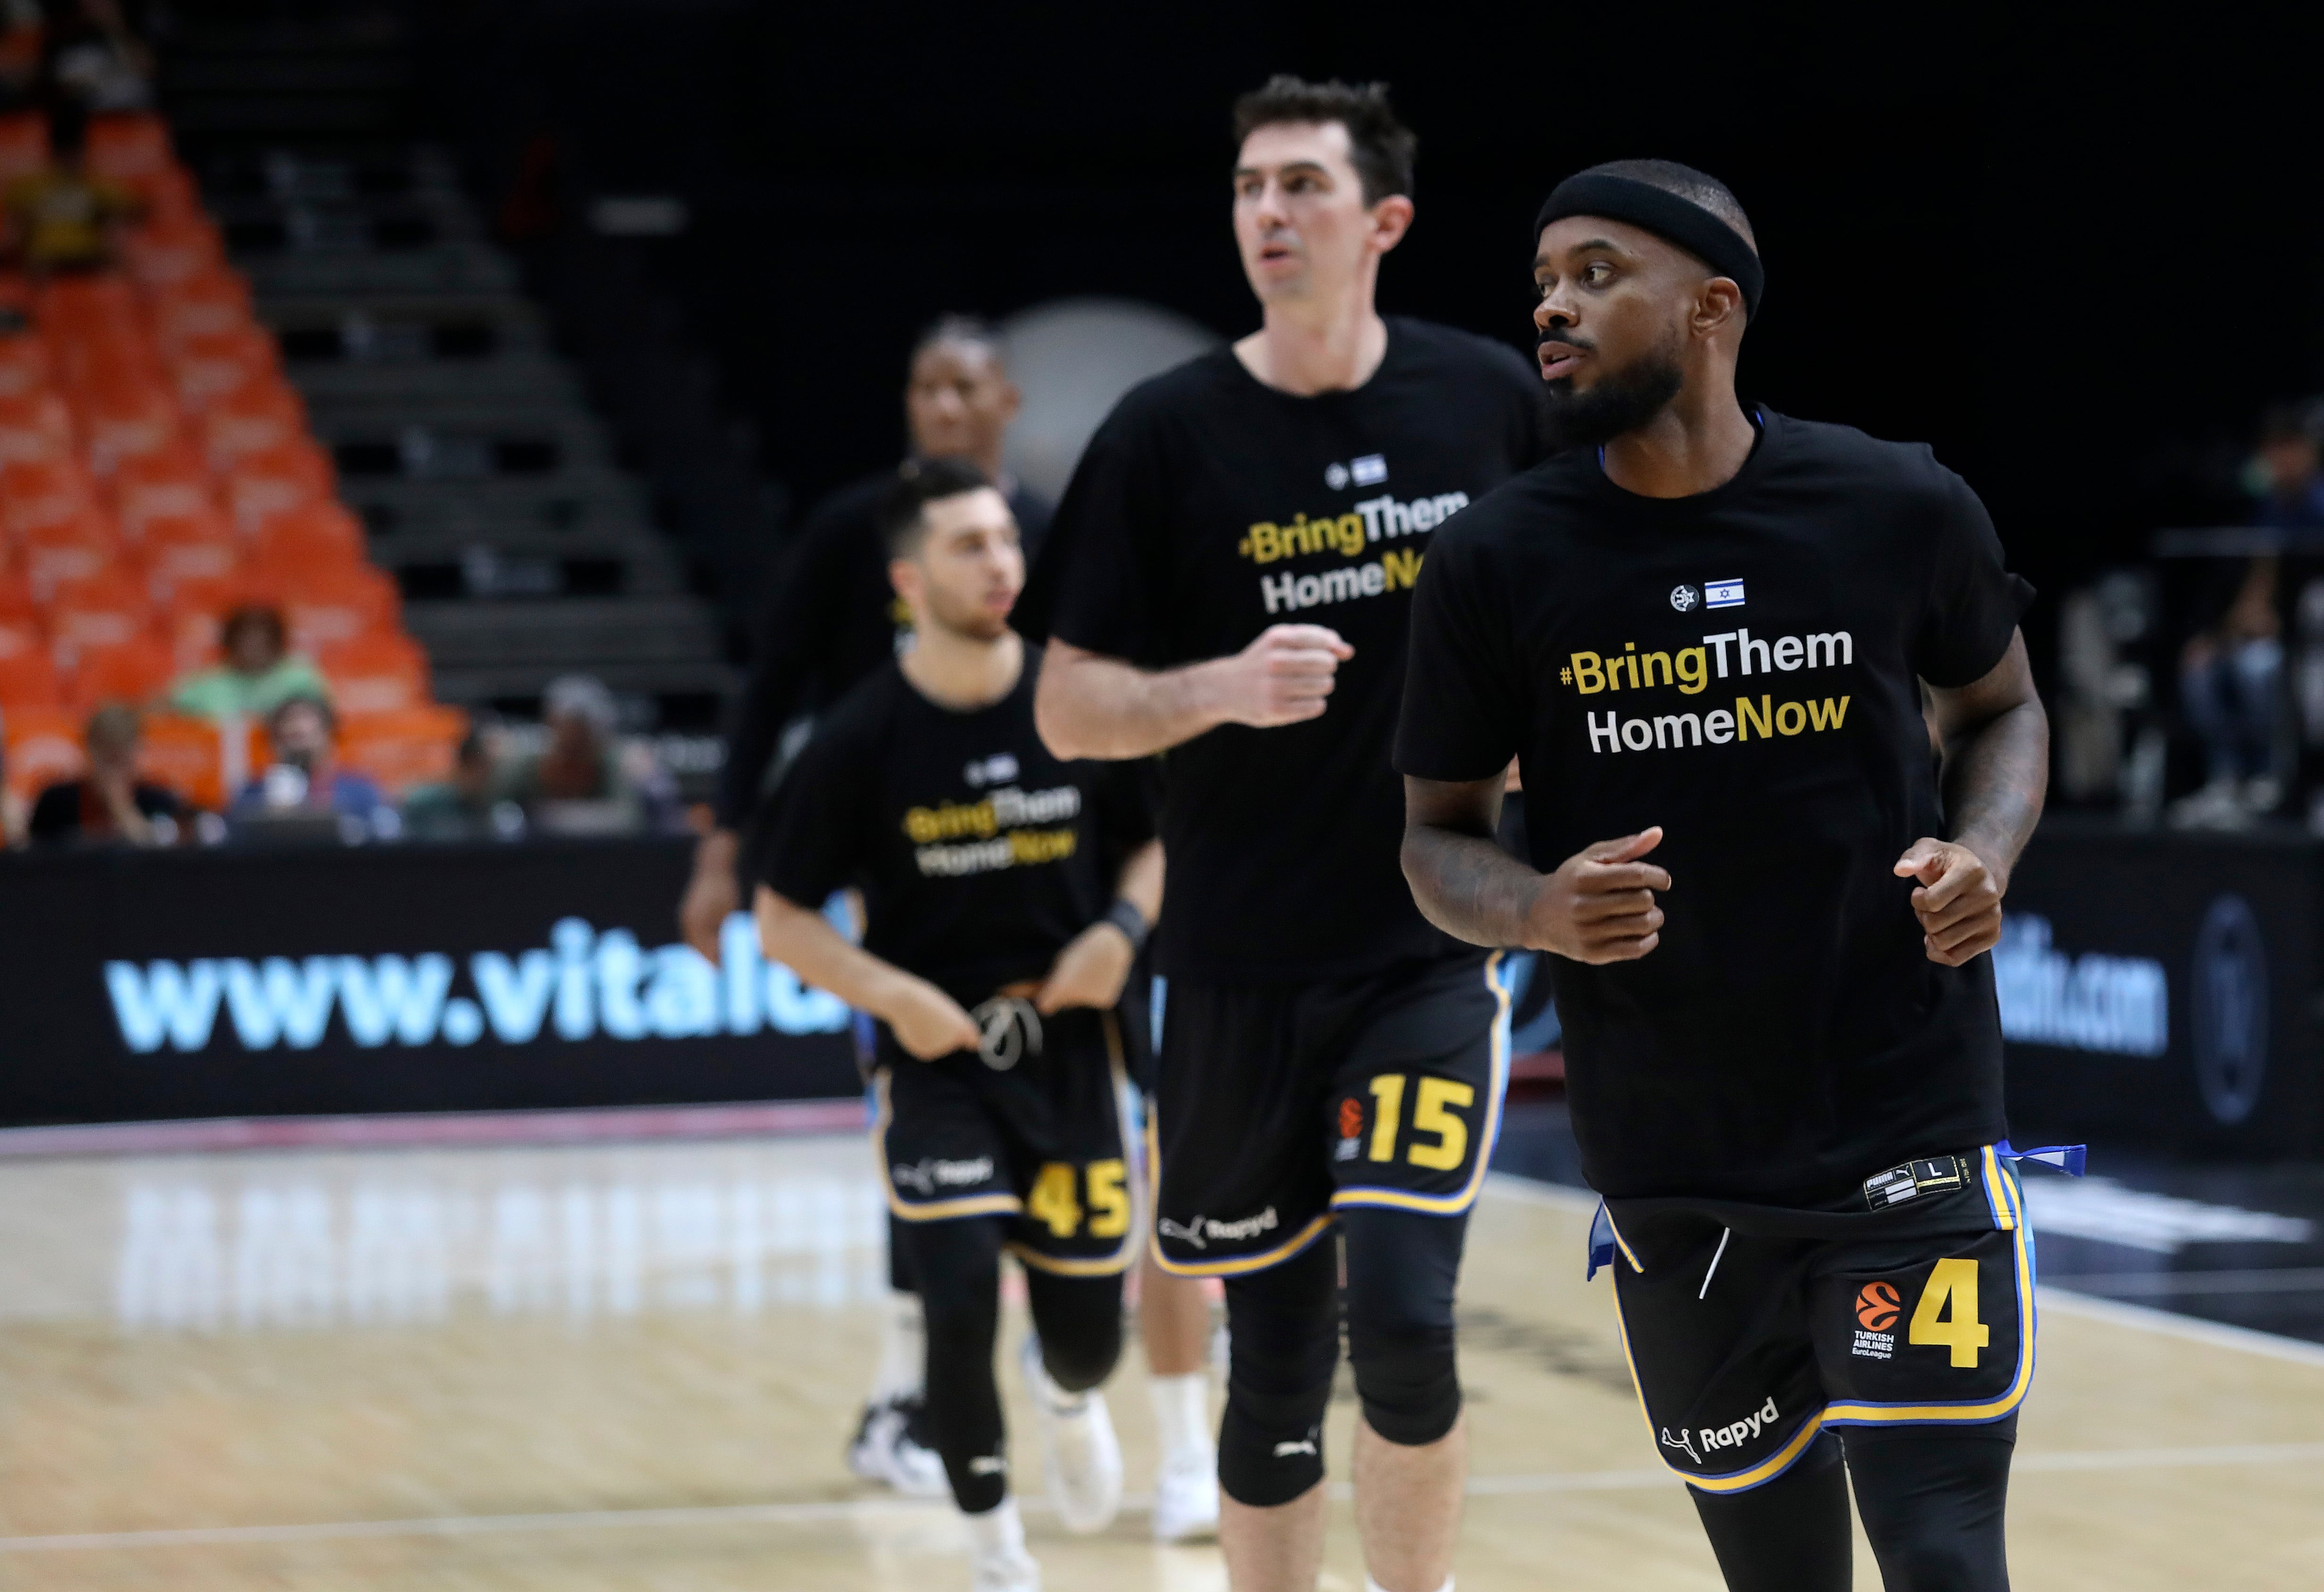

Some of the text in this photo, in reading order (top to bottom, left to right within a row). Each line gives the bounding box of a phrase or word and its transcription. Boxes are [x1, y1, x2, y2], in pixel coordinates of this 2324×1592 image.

[1260, 547, 1424, 614] HomeN
[1560, 628, 1853, 695] #BringThem
[1587, 694, 1851, 753] HomeNow
[1369, 1073, 1475, 1171] 15
[1866, 1171, 1894, 1188] PUMA
[1927, 1162, 1942, 1177] L
[1028, 1158, 1130, 1239] 45
[1854, 1330, 1895, 1343] TURKISH
[1909, 1258, 1990, 1368] 4
[1851, 1348, 1892, 1360] EuroLeague
[1852, 1340, 1893, 1352] AIRLINES
[1699, 1396, 1780, 1452] Rapyd
